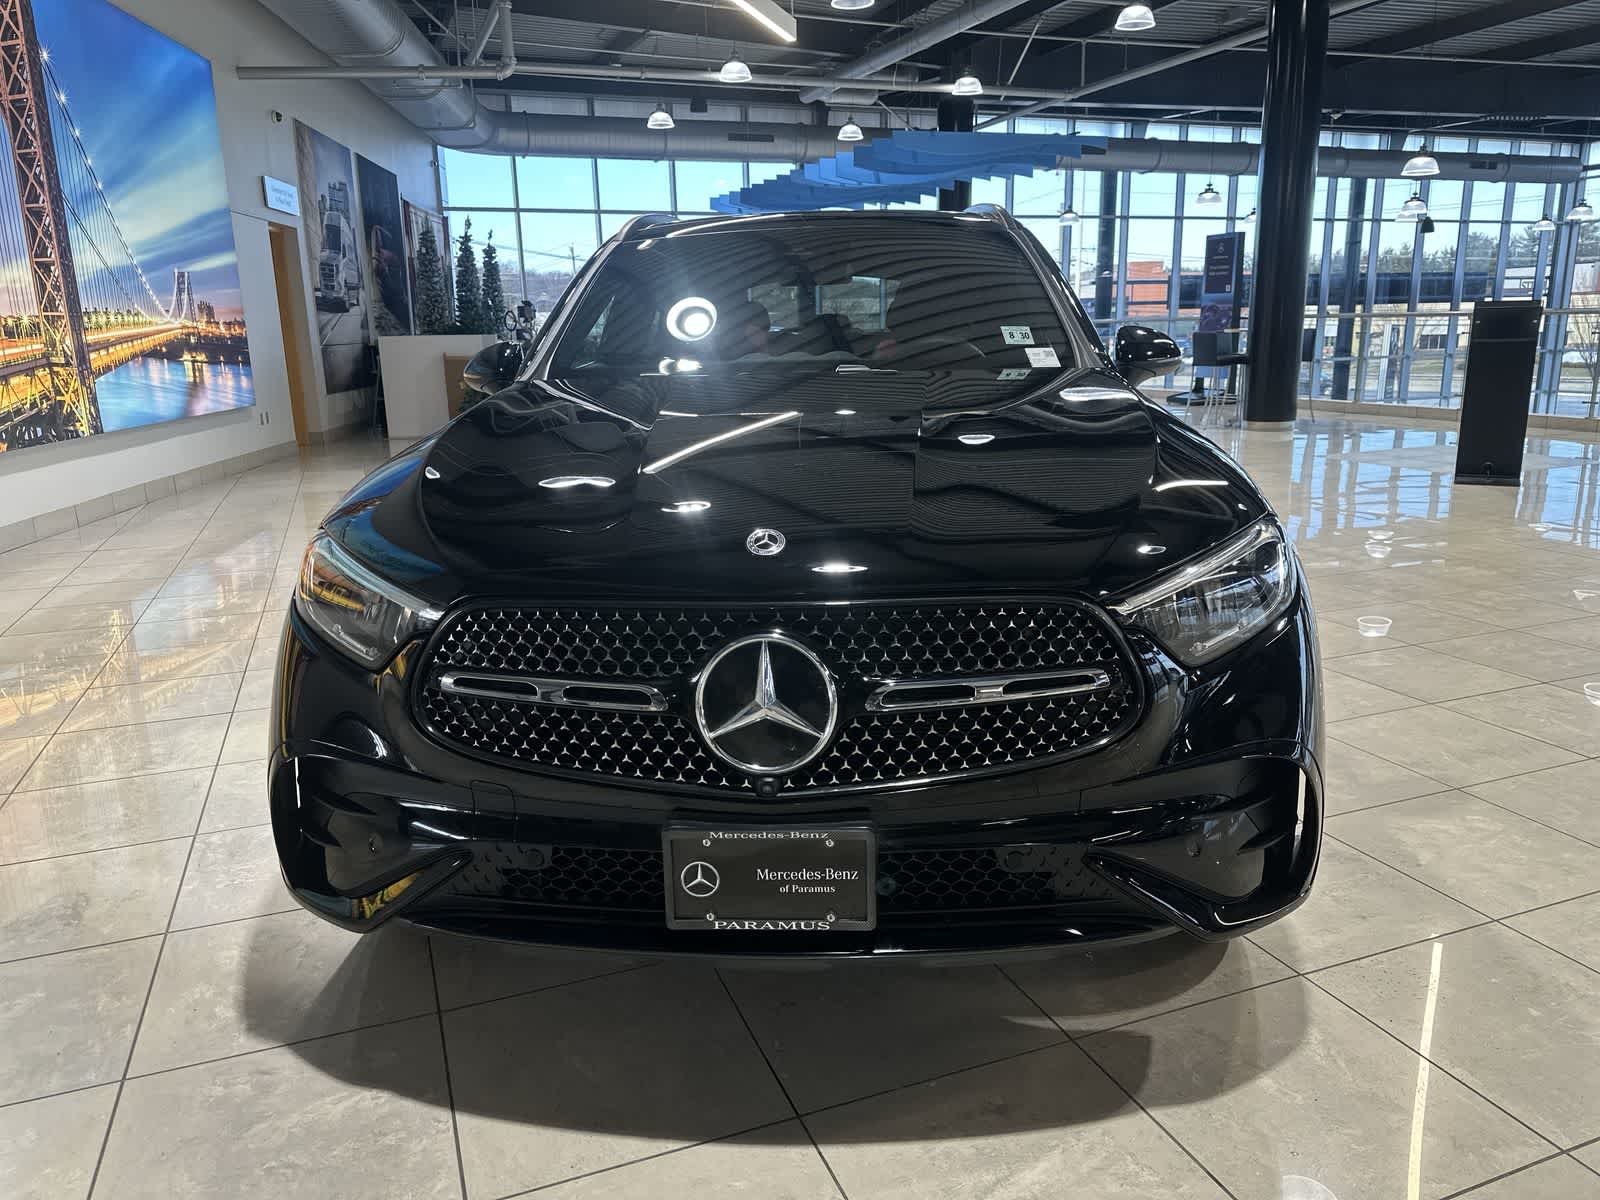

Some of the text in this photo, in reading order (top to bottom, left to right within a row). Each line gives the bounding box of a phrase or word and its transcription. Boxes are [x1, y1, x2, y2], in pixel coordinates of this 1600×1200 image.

[1009, 331, 1030, 340] 8 30
[709, 831, 829, 840] Mercedes-Benz
[756, 867, 859, 881] Mercedes-Benz
[779, 884, 836, 894] of Paramus
[713, 920, 831, 931] PARAMUS
